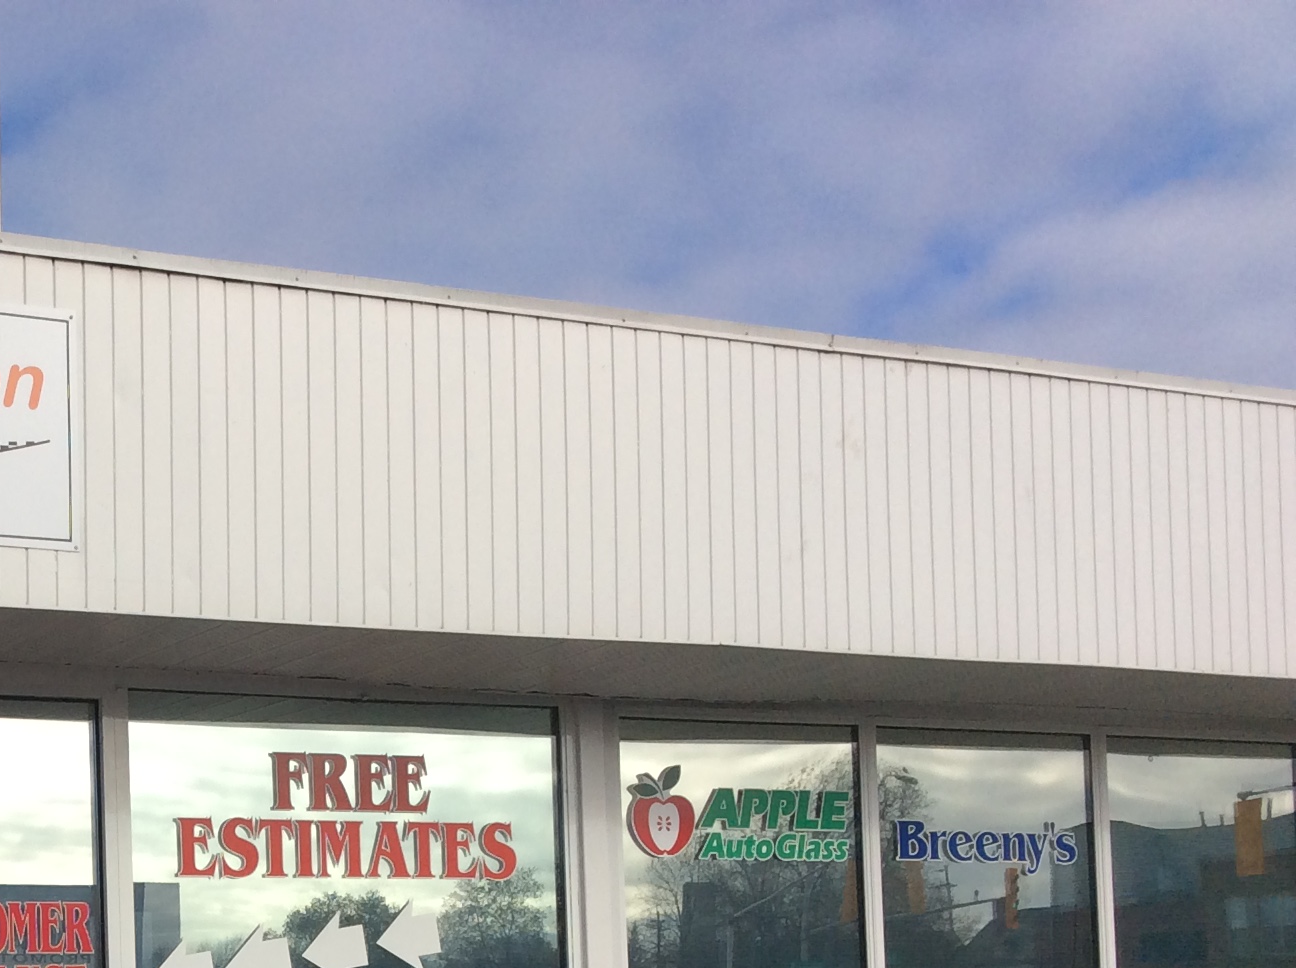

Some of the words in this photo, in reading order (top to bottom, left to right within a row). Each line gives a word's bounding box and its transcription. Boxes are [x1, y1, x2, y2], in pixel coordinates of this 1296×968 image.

[269, 751, 431, 814] FREE
[697, 788, 850, 831] APPLE
[172, 816, 517, 881] ESTIMATES
[894, 820, 1077, 876] Breeny's
